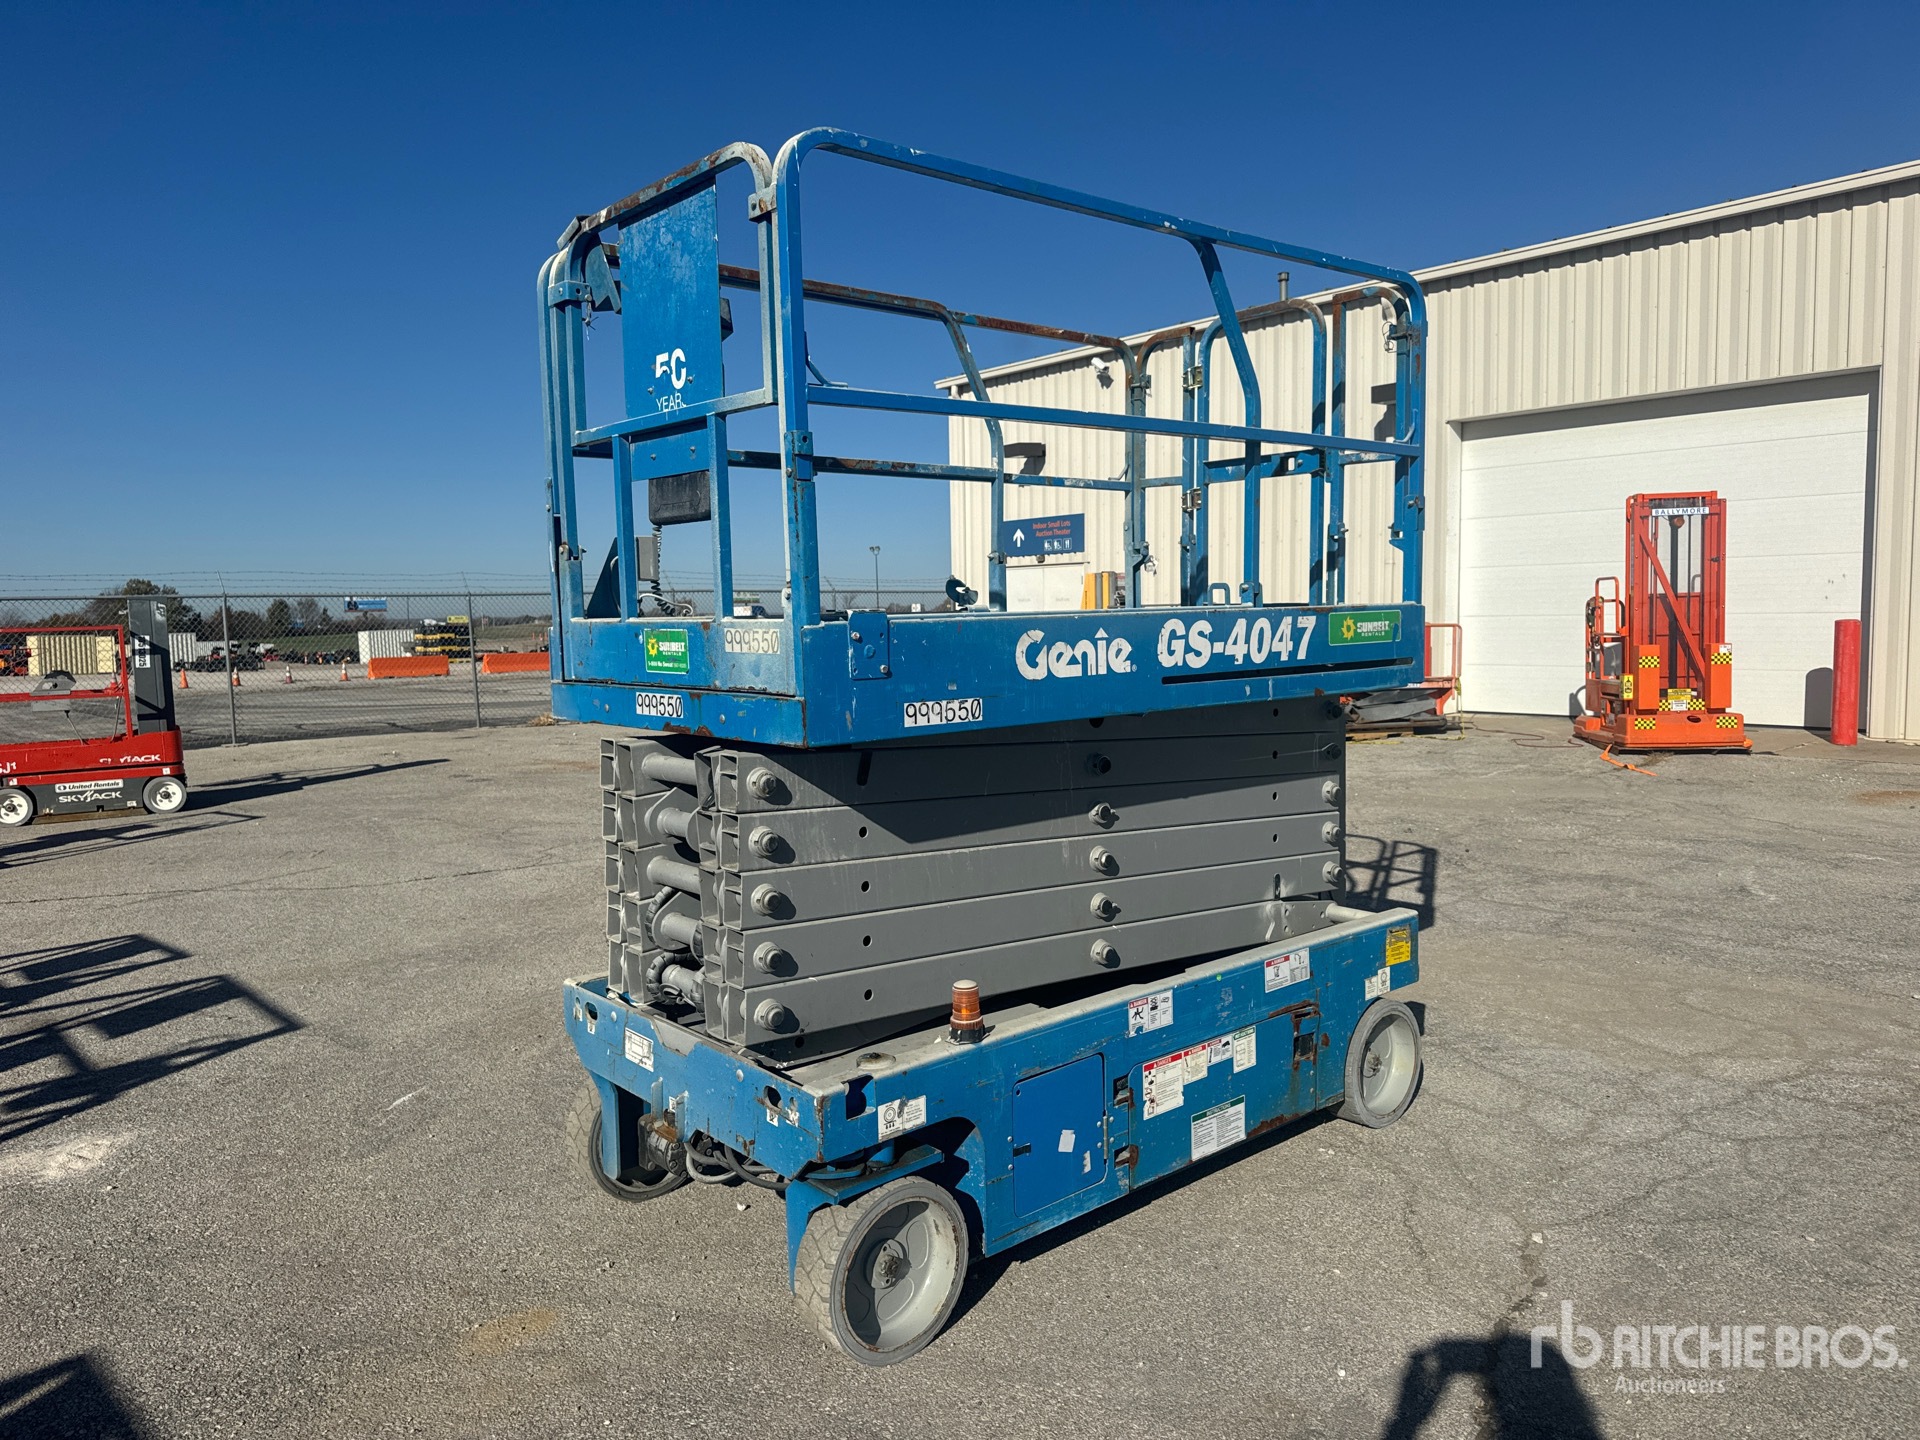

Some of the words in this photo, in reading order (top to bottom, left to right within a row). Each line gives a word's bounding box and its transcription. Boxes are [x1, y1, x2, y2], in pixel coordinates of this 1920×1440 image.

[655, 392, 687, 412] YEAR
[1356, 620, 1390, 633] SUNBELT
[658, 641, 686, 652] SUNBELT
[725, 629, 779, 654] 999550
[1157, 615, 1317, 669] GS-4047
[1015, 627, 1132, 681] Genie
[636, 693, 683, 717] 999550
[905, 699, 982, 725] 999550
[58, 790, 123, 803] SKYJACK
